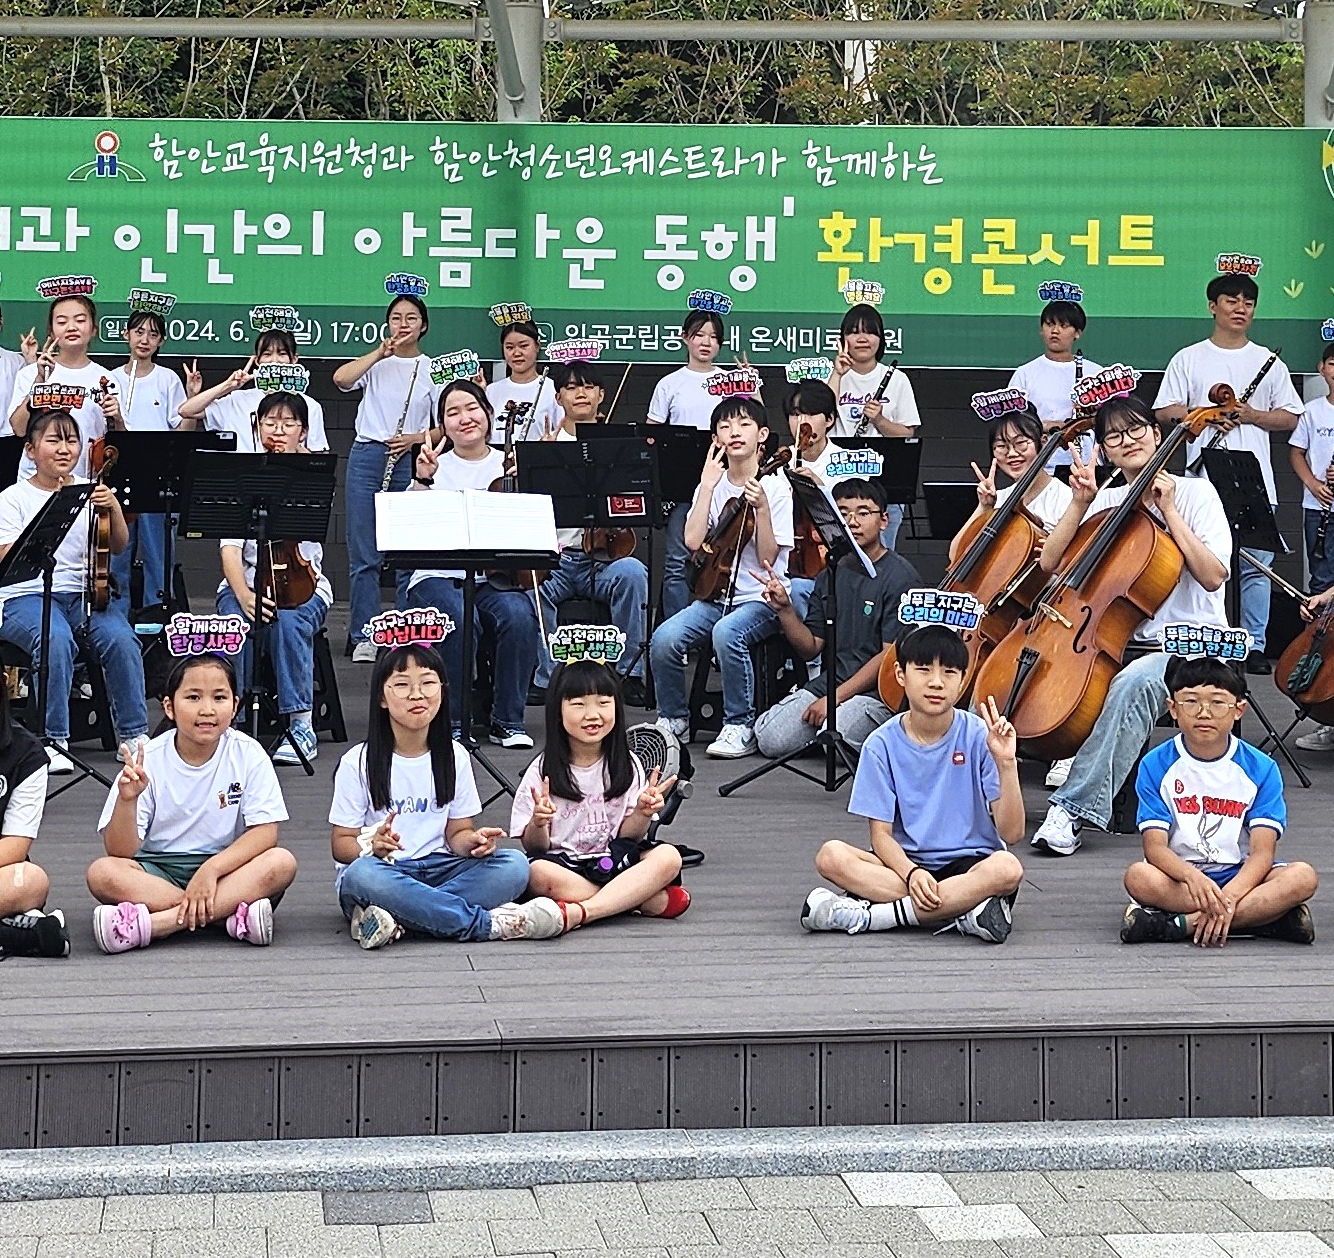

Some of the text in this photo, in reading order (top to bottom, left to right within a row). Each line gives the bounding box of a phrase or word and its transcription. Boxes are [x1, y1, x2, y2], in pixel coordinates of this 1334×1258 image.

[149, 133, 944, 187] 함안교육지원청과 함안청소년오케스트라가 함께하는
[113, 207, 325, 284] 인간의
[354, 207, 617, 290] 아름다운
[817, 211, 1165, 295] 환경콘서트
[163, 319, 220, 342] 024.
[565, 323, 683, 350] 입곡군립공
[749, 325, 903, 354] 온새미로원
[260, 366, 303, 377] 실천해요
[431, 352, 470, 372] 실천해요
[430, 361, 477, 384] 녹색 생활
[257, 376, 306, 390] 녹색 생활
[1080, 376, 1133, 404] 아닙니다
[911, 592, 976, 613] 푸른 지구는
[175, 617, 240, 634] 함께해요
[901, 604, 978, 628] 우리의 미래
[374, 626, 443, 644] 아닙니다
[559, 628, 617, 645] 실천해요
[1166, 626, 1246, 644] 푸른하늘을 위한
[553, 642, 621, 659] 녹색 생활
[1166, 640, 1245, 658] 오늘의 한걸음
[389, 797, 428, 815] YAN
